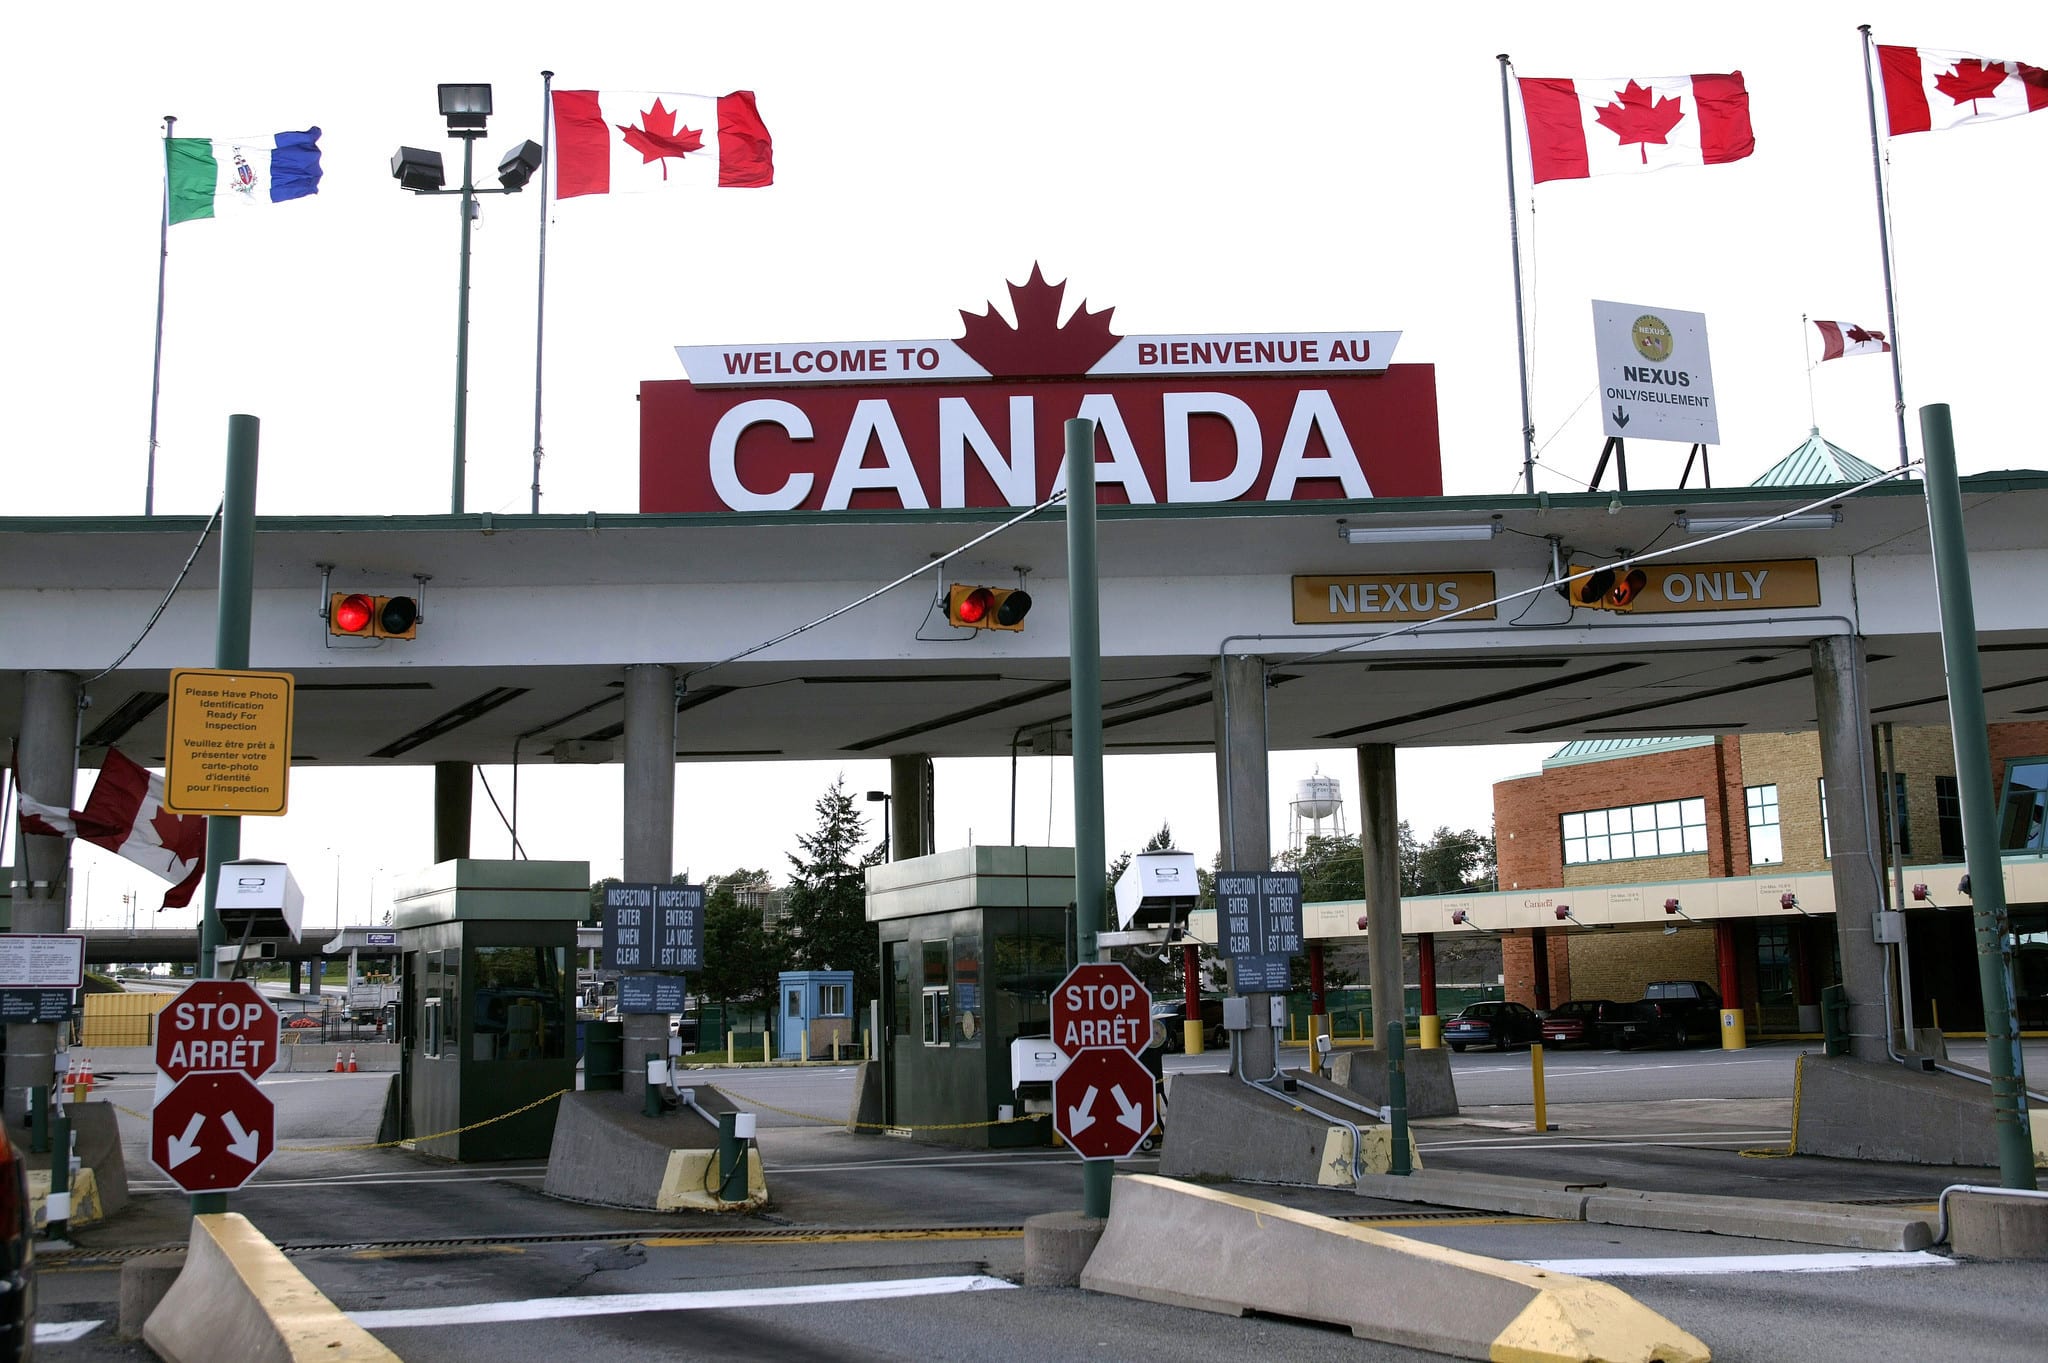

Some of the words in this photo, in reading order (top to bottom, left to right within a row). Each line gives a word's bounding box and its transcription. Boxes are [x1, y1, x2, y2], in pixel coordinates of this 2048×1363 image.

[1639, 327, 1665, 336] NEXUS
[723, 348, 889, 375] WELCOME
[896, 347, 940, 371] TO
[1138, 341, 1319, 366] BIENVENUE
[1328, 340, 1371, 363] AU
[1623, 365, 1690, 387] NEXUS
[1606, 387, 1710, 407] ONLY/SEULEMENT
[708, 388, 1374, 512] CANADA
[1328, 581, 1460, 613] NEXUS
[1662, 570, 1769, 603] ONLY
[185, 688, 219, 697] Please
[222, 690, 247, 698] Have
[250, 691, 278, 700] Photo
[200, 700, 264, 709] Identification
[207, 710, 238, 720] Ready
[241, 711, 257, 720] For
[205, 721, 257, 731] Inspection
[184, 739, 222, 748] Veuillez
[225, 740, 244, 748] être
[247, 741, 266, 750] prêt
[269, 742, 275, 750] à
[191, 750, 239, 760] présenter
[242, 752, 267, 760] votre
[201, 762, 259, 771] carte-photo
[205, 773, 251, 782] d'identité
[186, 785, 210, 793] pour
[213, 785, 269, 794] l'inspection
[1219, 878, 1256, 895] INSPECTION
[1262, 878, 1298, 894] INSPECTION
[608, 889, 651, 906] INSPECTION
[658, 890, 701, 907] INSPECTION
[1228, 897, 1249, 914] ENTER
[1269, 897, 1294, 913] ENTRER
[1524, 899, 1553, 909] Canada
[617, 909, 641, 926] ENTER
[665, 910, 693, 926] ENTRER
[1230, 917, 1249, 934] WHEN
[1270, 916, 1279, 932] LA
[1280, 916, 1295, 932] VOIE
[617, 928, 640, 945] WHEN
[666, 929, 675, 945] LA
[677, 929, 693, 945] VOIE
[1230, 936, 1250, 953] CLEAR
[1268, 935, 1279, 952] EST
[1281, 935, 1299, 952] LIBRE
[616, 948, 640, 965] CLEAR
[661, 948, 675, 965] EST
[676, 948, 697, 965] LIBRE
[1066, 984, 1136, 1012] STOP
[175, 1002, 263, 1031] STOP
[1063, 1013, 1140, 1046] ARRÊT
[167, 1034, 265, 1068] ARRÊT
